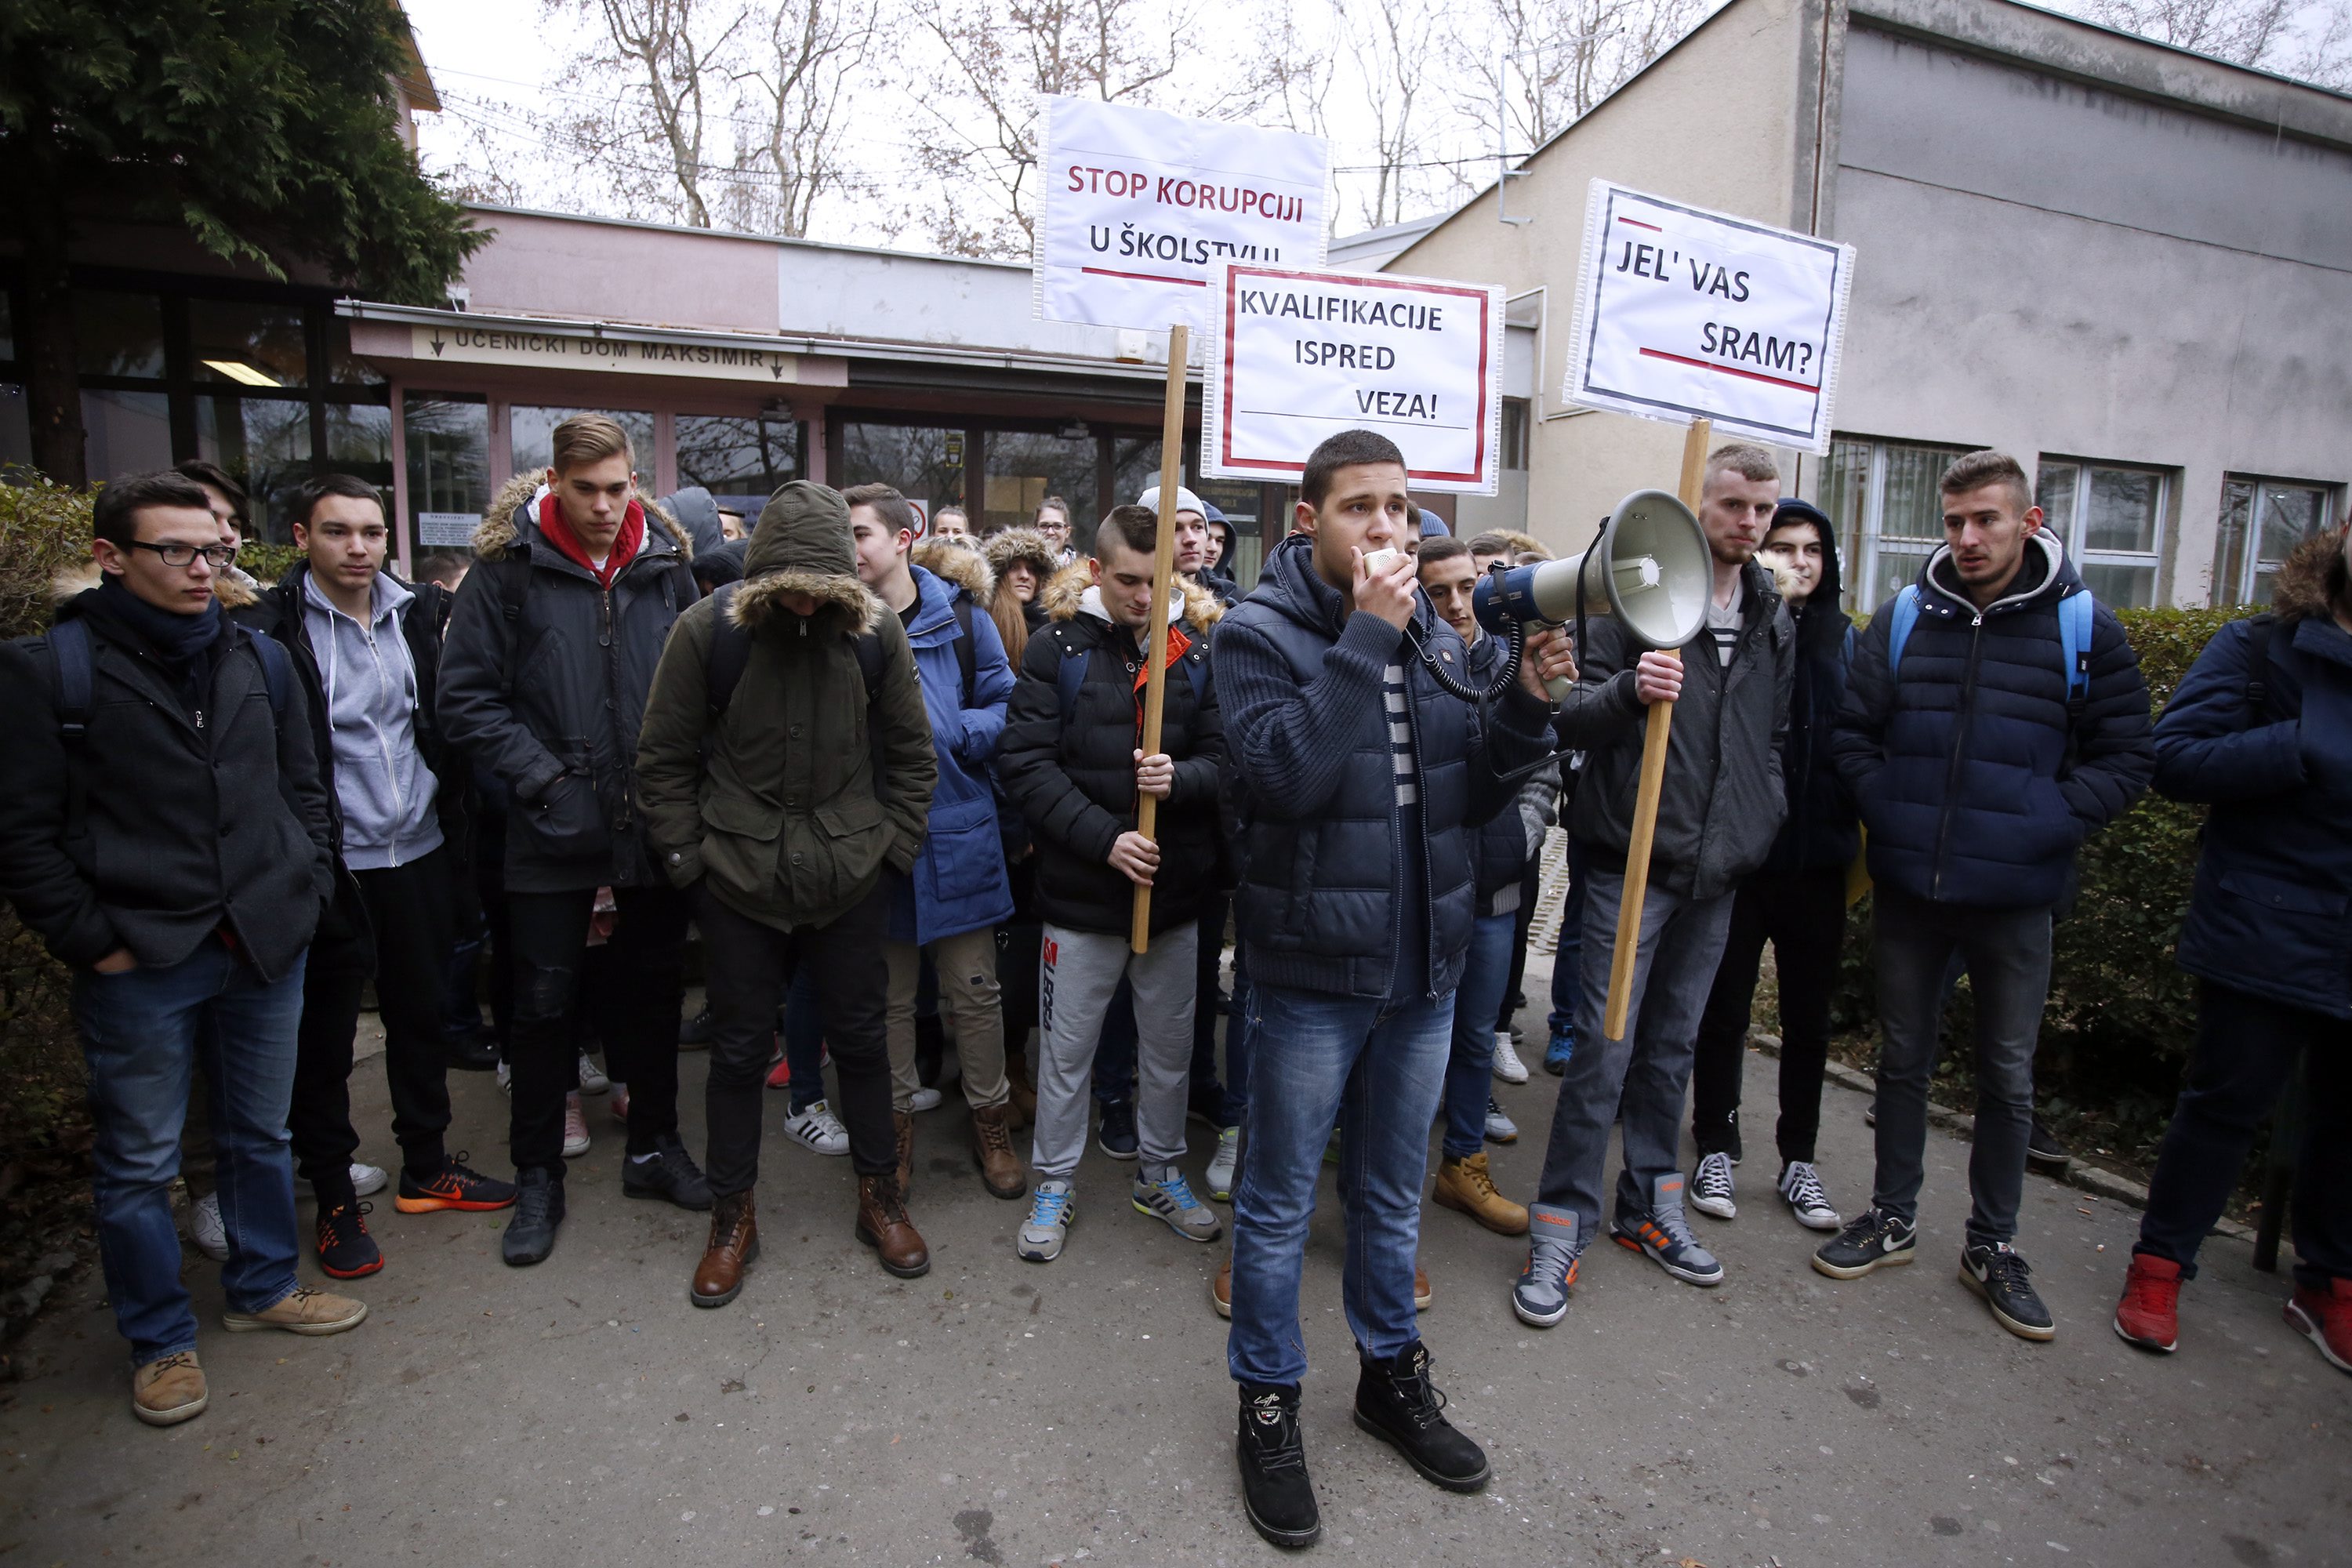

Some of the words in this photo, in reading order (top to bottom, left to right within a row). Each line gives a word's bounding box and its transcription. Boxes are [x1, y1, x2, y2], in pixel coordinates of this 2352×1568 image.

[1068, 165, 1148, 199] STOP
[1156, 177, 1303, 223] KORUPCIJI
[1091, 225, 1109, 252] U
[1617, 241, 1679, 282] JEL'
[1689, 258, 1750, 302] VAS
[1241, 290, 1443, 332] KVALIFIKACIJE
[456, 328, 566, 353] UČENIČKI
[579, 340, 628, 358] DOM
[641, 342, 764, 367] MAKSIMIR
[1295, 339, 1396, 371] ISPRED
[1700, 322, 1813, 375] SRAM?
[1356, 390, 1437, 419] VEZA!
[1536, 1213, 1571, 1227] adidas
